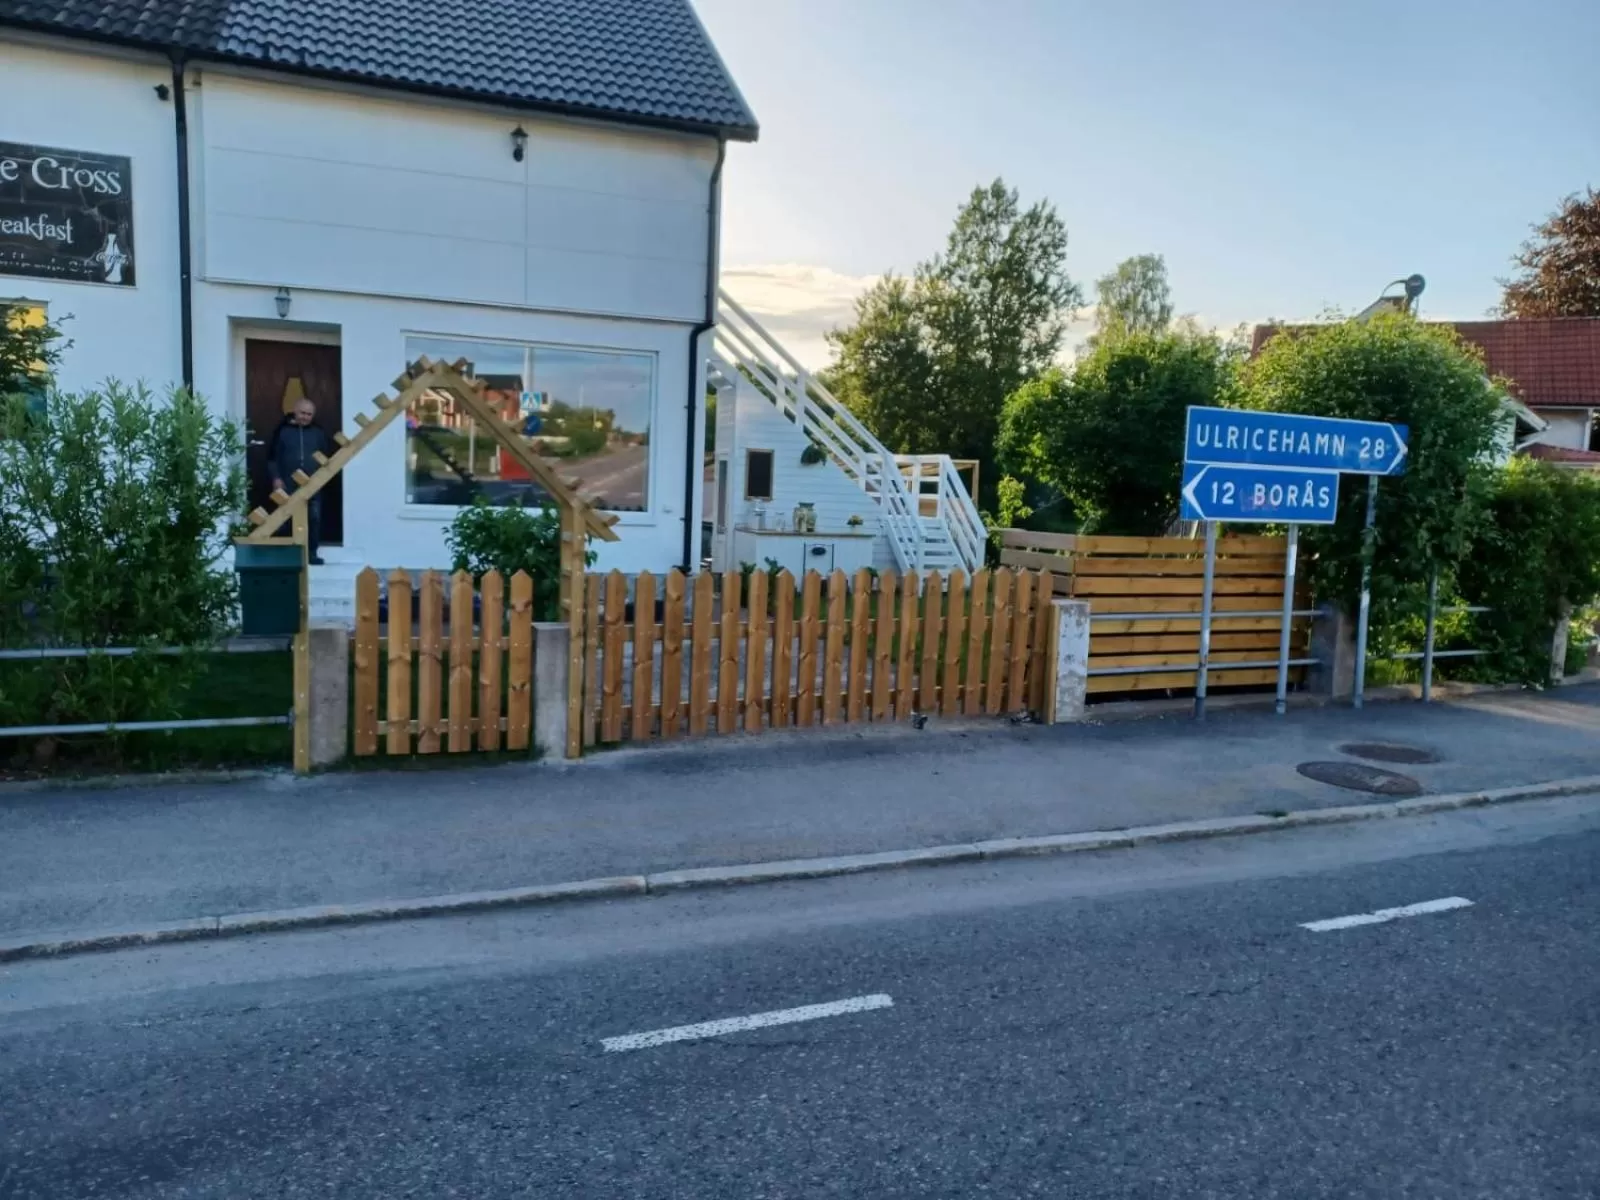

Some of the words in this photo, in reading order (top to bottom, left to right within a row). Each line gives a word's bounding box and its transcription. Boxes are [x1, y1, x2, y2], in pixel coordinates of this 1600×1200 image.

[0, 160, 19, 183] e
[32, 157, 122, 194] Cross
[0, 213, 74, 244] eakfast
[1196, 423, 1346, 457] ULRICEHAMN
[1359, 437, 1385, 460] 28
[1211, 481, 1236, 505] 12
[1252, 479, 1331, 508] BORÅS
